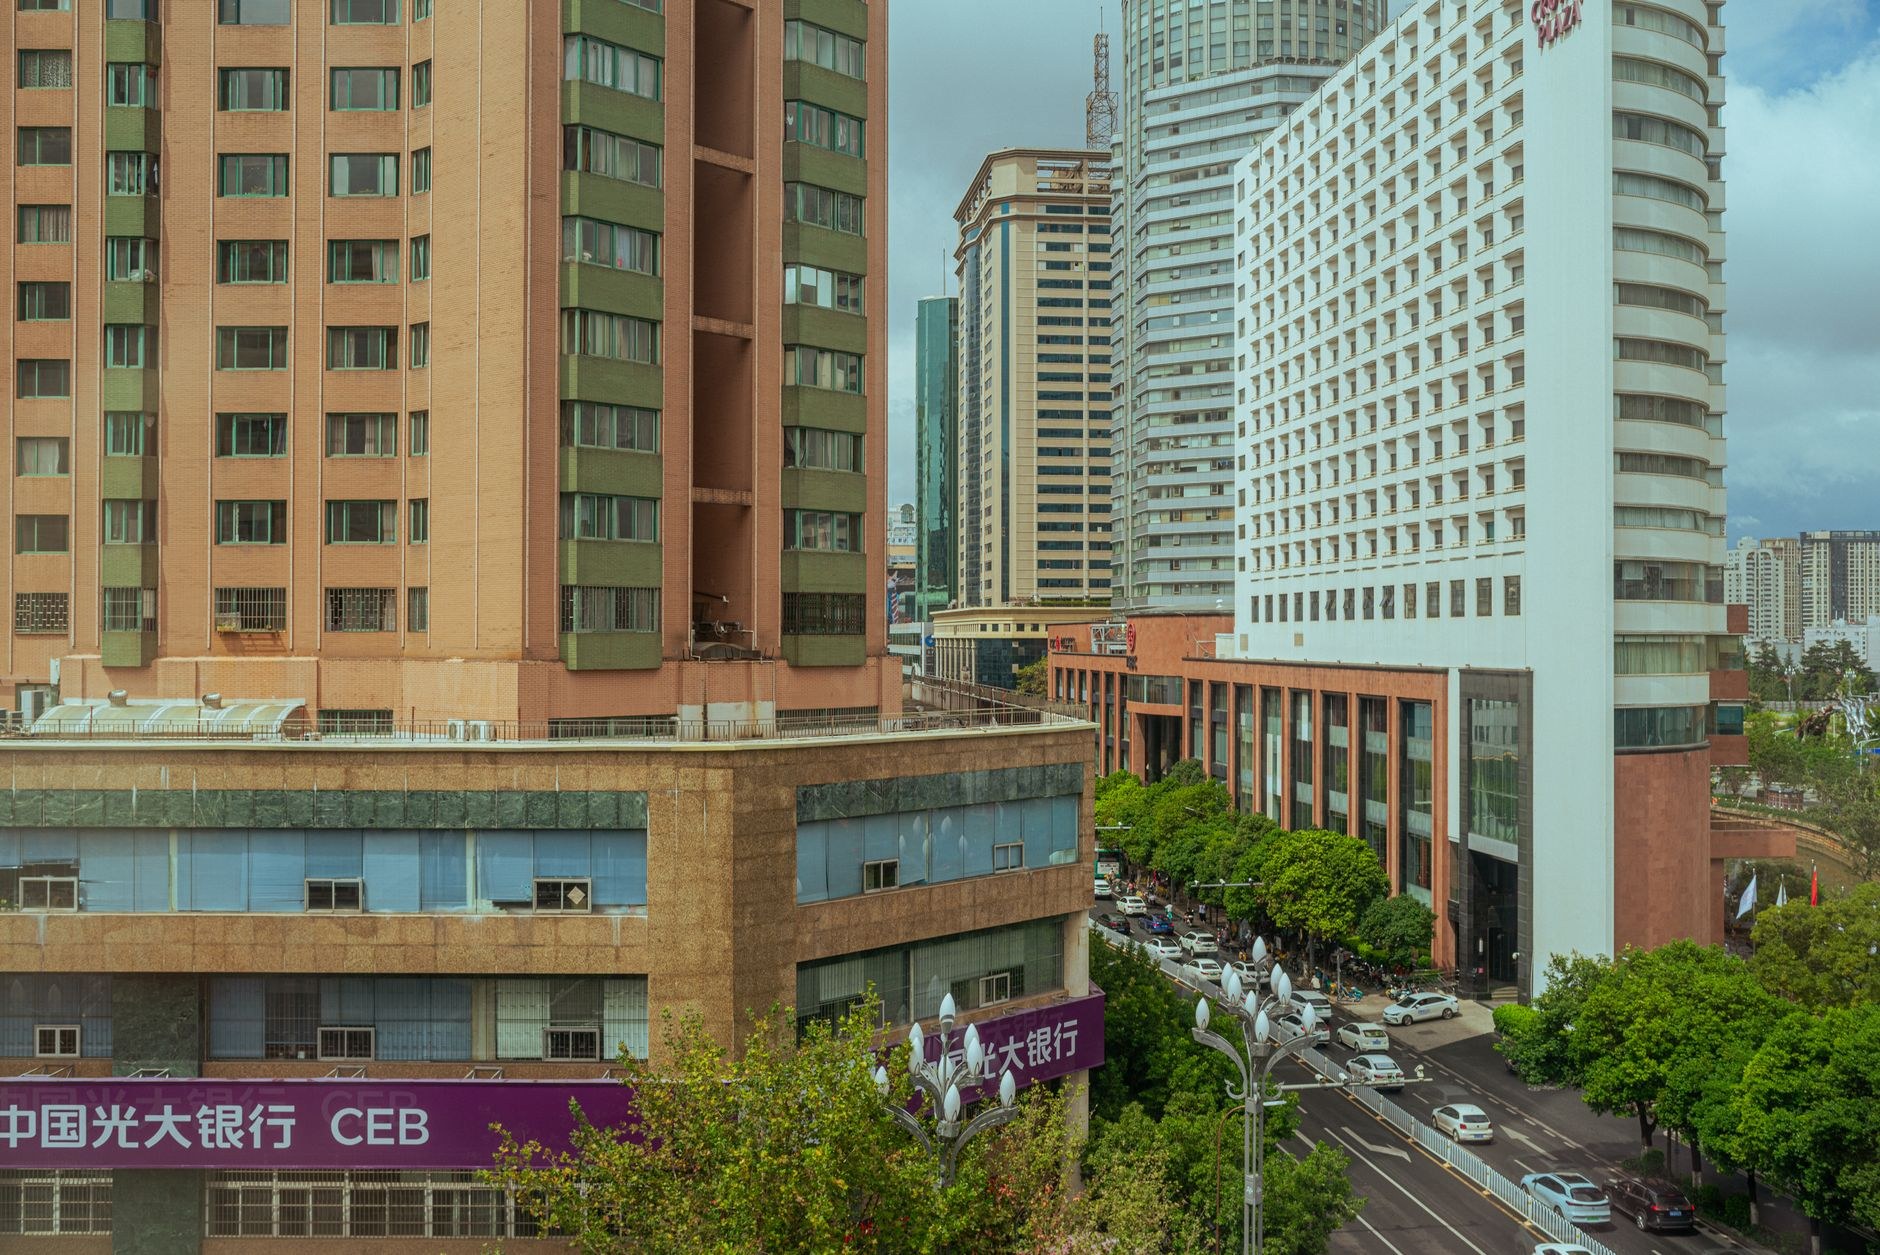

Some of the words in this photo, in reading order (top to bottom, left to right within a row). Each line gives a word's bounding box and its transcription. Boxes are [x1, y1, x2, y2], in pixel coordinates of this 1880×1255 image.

[1538, 0, 1582, 48] PLAZA
[0, 1104, 296, 1149] 中国光大银行
[331, 1108, 430, 1146] CEB
